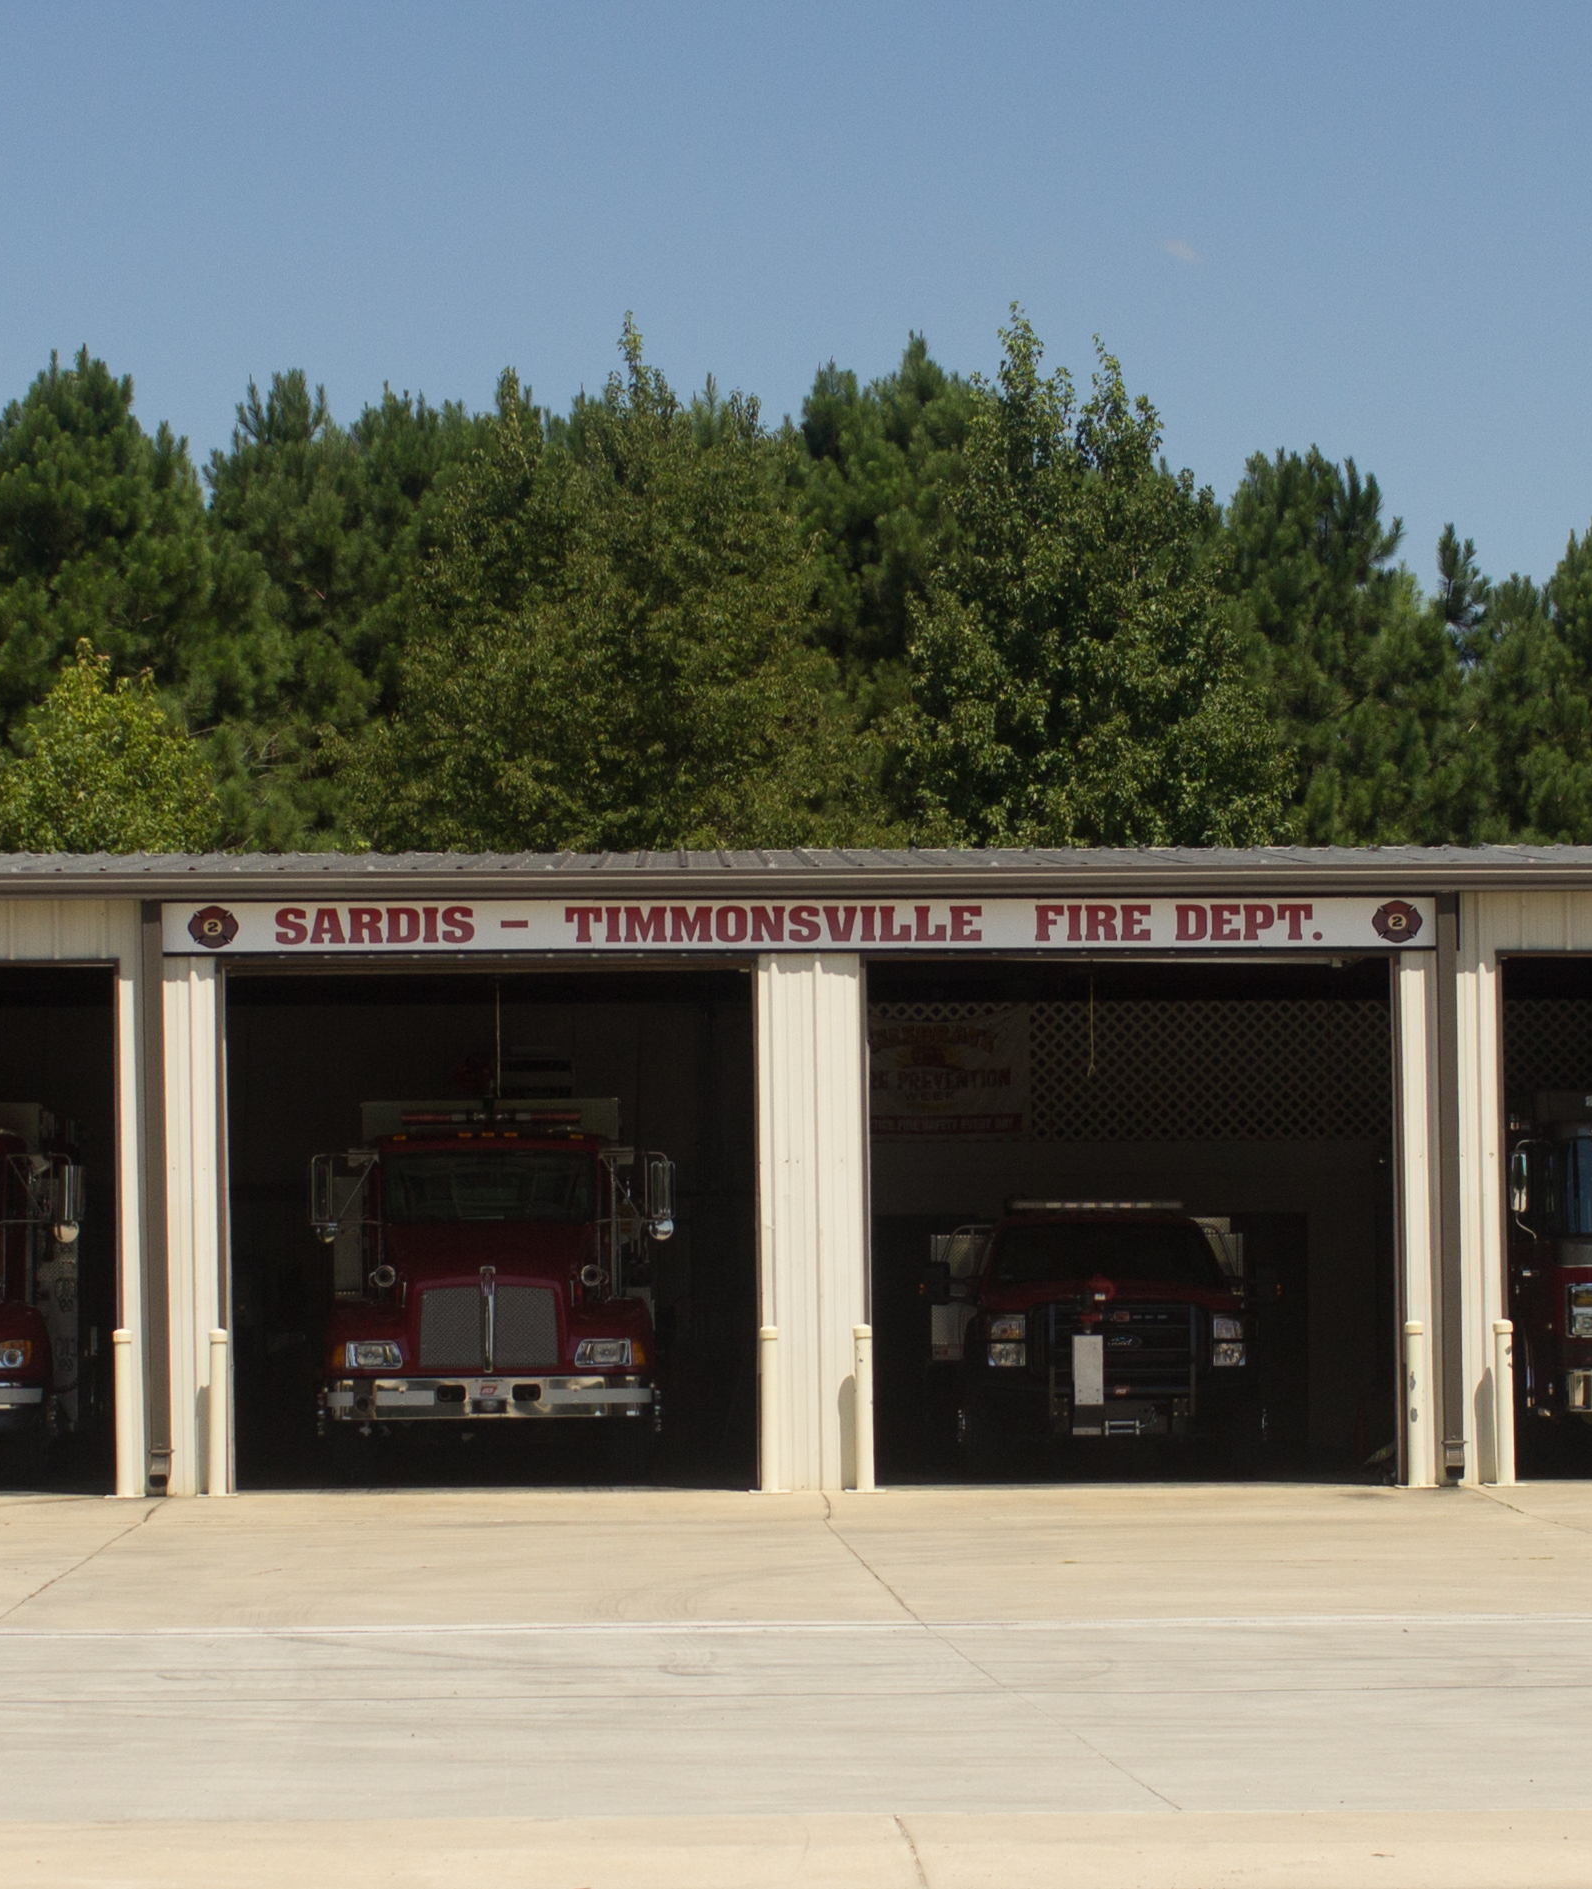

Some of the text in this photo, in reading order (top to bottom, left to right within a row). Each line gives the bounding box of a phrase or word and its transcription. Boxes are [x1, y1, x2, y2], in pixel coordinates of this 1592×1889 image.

[207, 921, 219, 933] 2
[275, 907, 475, 945] SARDIS
[564, 905, 982, 943] TIMMONSVILLE
[1035, 904, 1151, 942] FIRE
[1174, 903, 1324, 941] DEPT.
[1391, 915, 1403, 927] 2
[897, 1067, 1011, 1090] PREVENTION
[905, 1091, 955, 1101] WEEK
